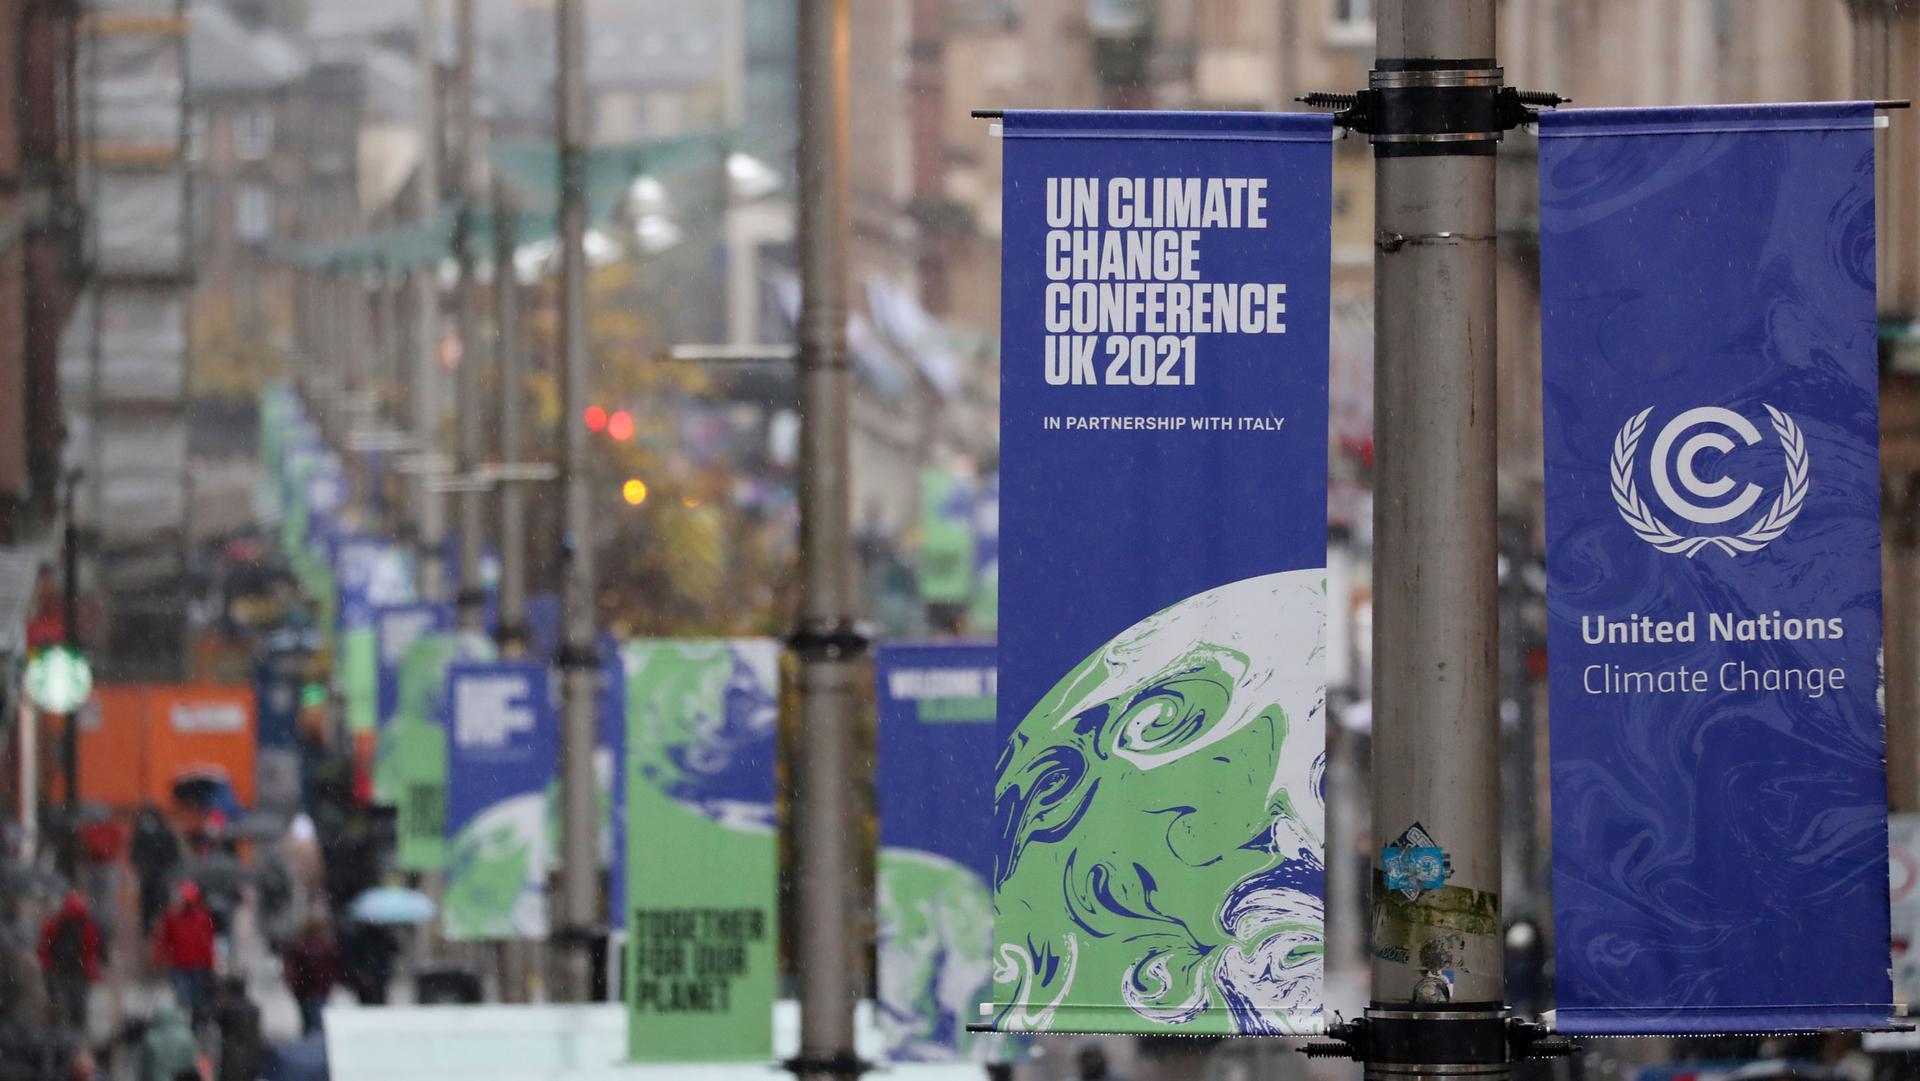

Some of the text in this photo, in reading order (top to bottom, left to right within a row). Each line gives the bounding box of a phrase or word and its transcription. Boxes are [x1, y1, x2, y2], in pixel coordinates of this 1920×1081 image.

[1046, 177, 1267, 229] UN CLIMATE
[1045, 230, 1200, 281] CHANGE
[1045, 282, 1287, 334] CONFERENCE
[1044, 334, 1196, 386] UK 2021
[1043, 416, 1285, 431] IN PARTNERSHIP WITH ITALY
[1581, 610, 1844, 645] United Nations
[1583, 661, 1846, 698] Climate Change
[636, 909, 764, 940] TOGETHER
[637, 944, 747, 976] FOR OUR
[636, 978, 730, 1012] PLANET
